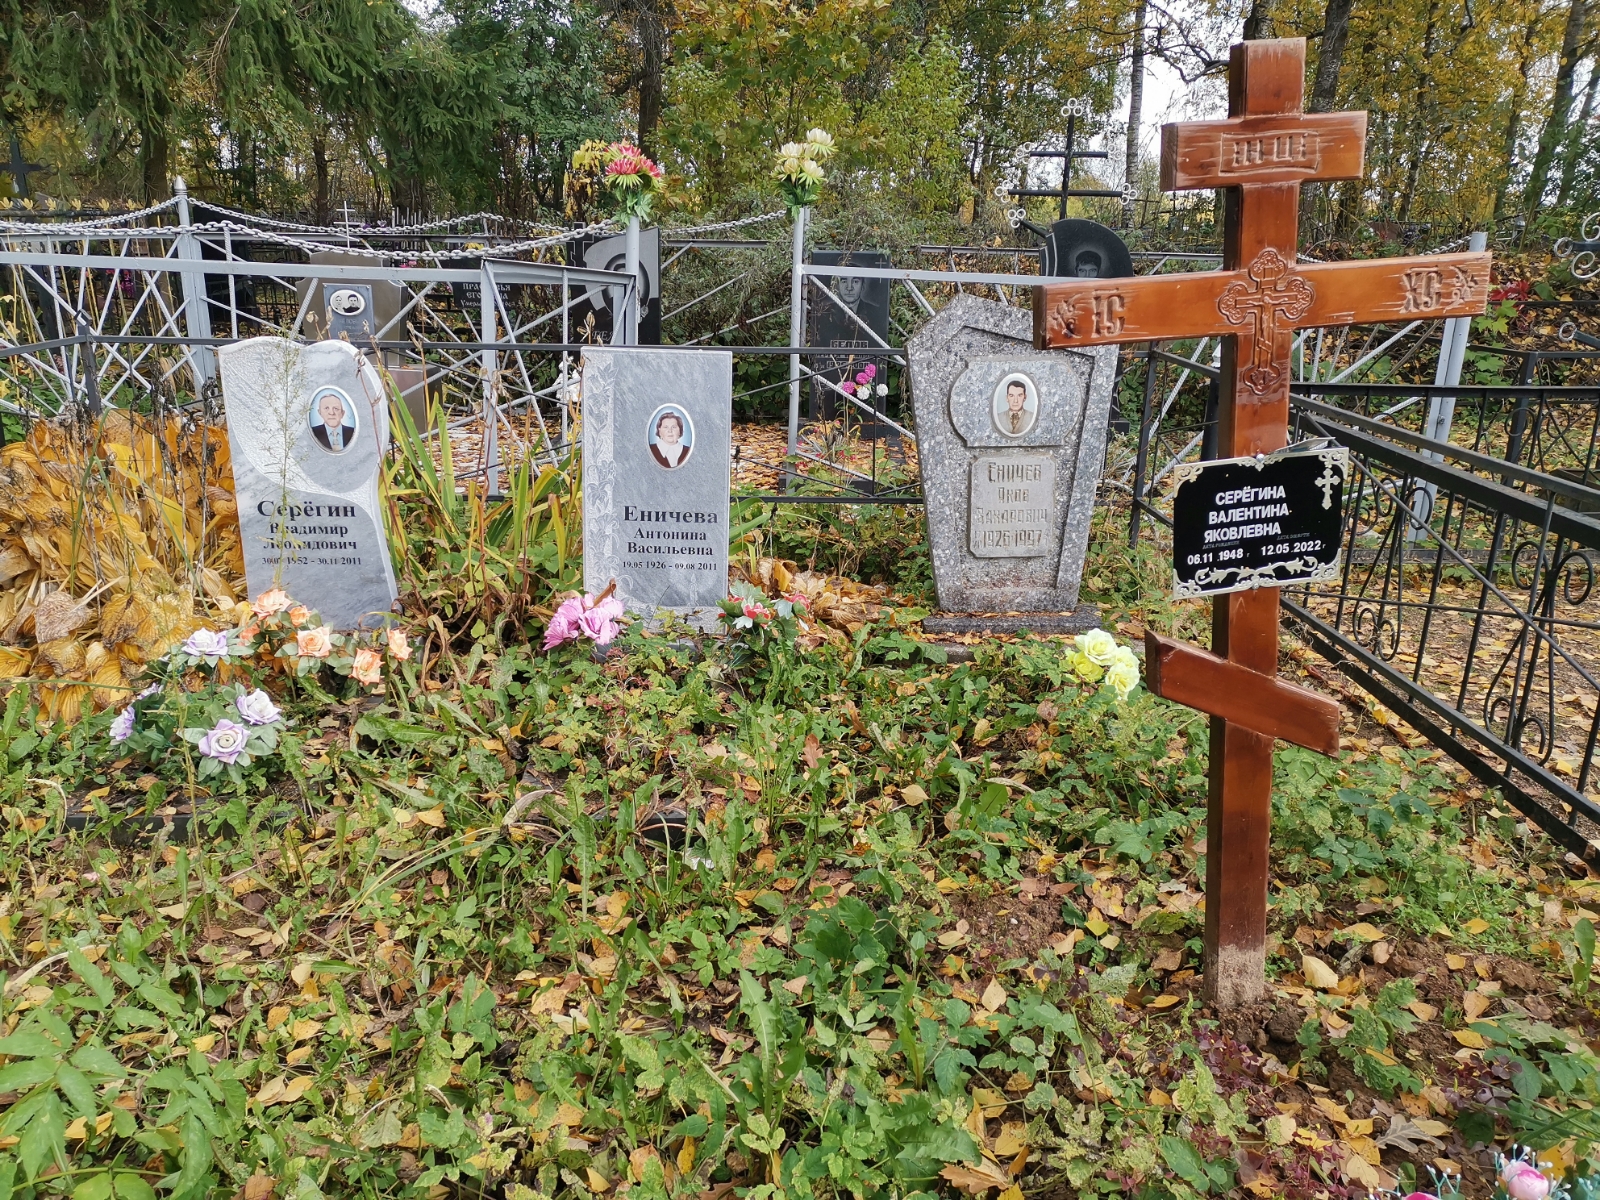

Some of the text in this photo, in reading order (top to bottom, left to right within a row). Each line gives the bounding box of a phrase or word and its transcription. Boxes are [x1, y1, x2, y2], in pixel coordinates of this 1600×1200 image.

[1215, 485, 1286, 505] СЕРЁГИНА
[257, 500, 356, 521] Серёгин
[623, 505, 718, 524] Еничева
[1208, 503, 1290, 525] ВАЛЕНТИНА
[633, 527, 707, 541] Антонина
[1204, 522, 1281, 543] ЯКОВЛЕВНА
[627, 542, 713, 556] Васильевна
[341, 557, 362, 565] 2011
[622, 561, 643, 569] 19.05
[645, 561, 666, 569] 1926
[697, 562, 717, 571] 2011
